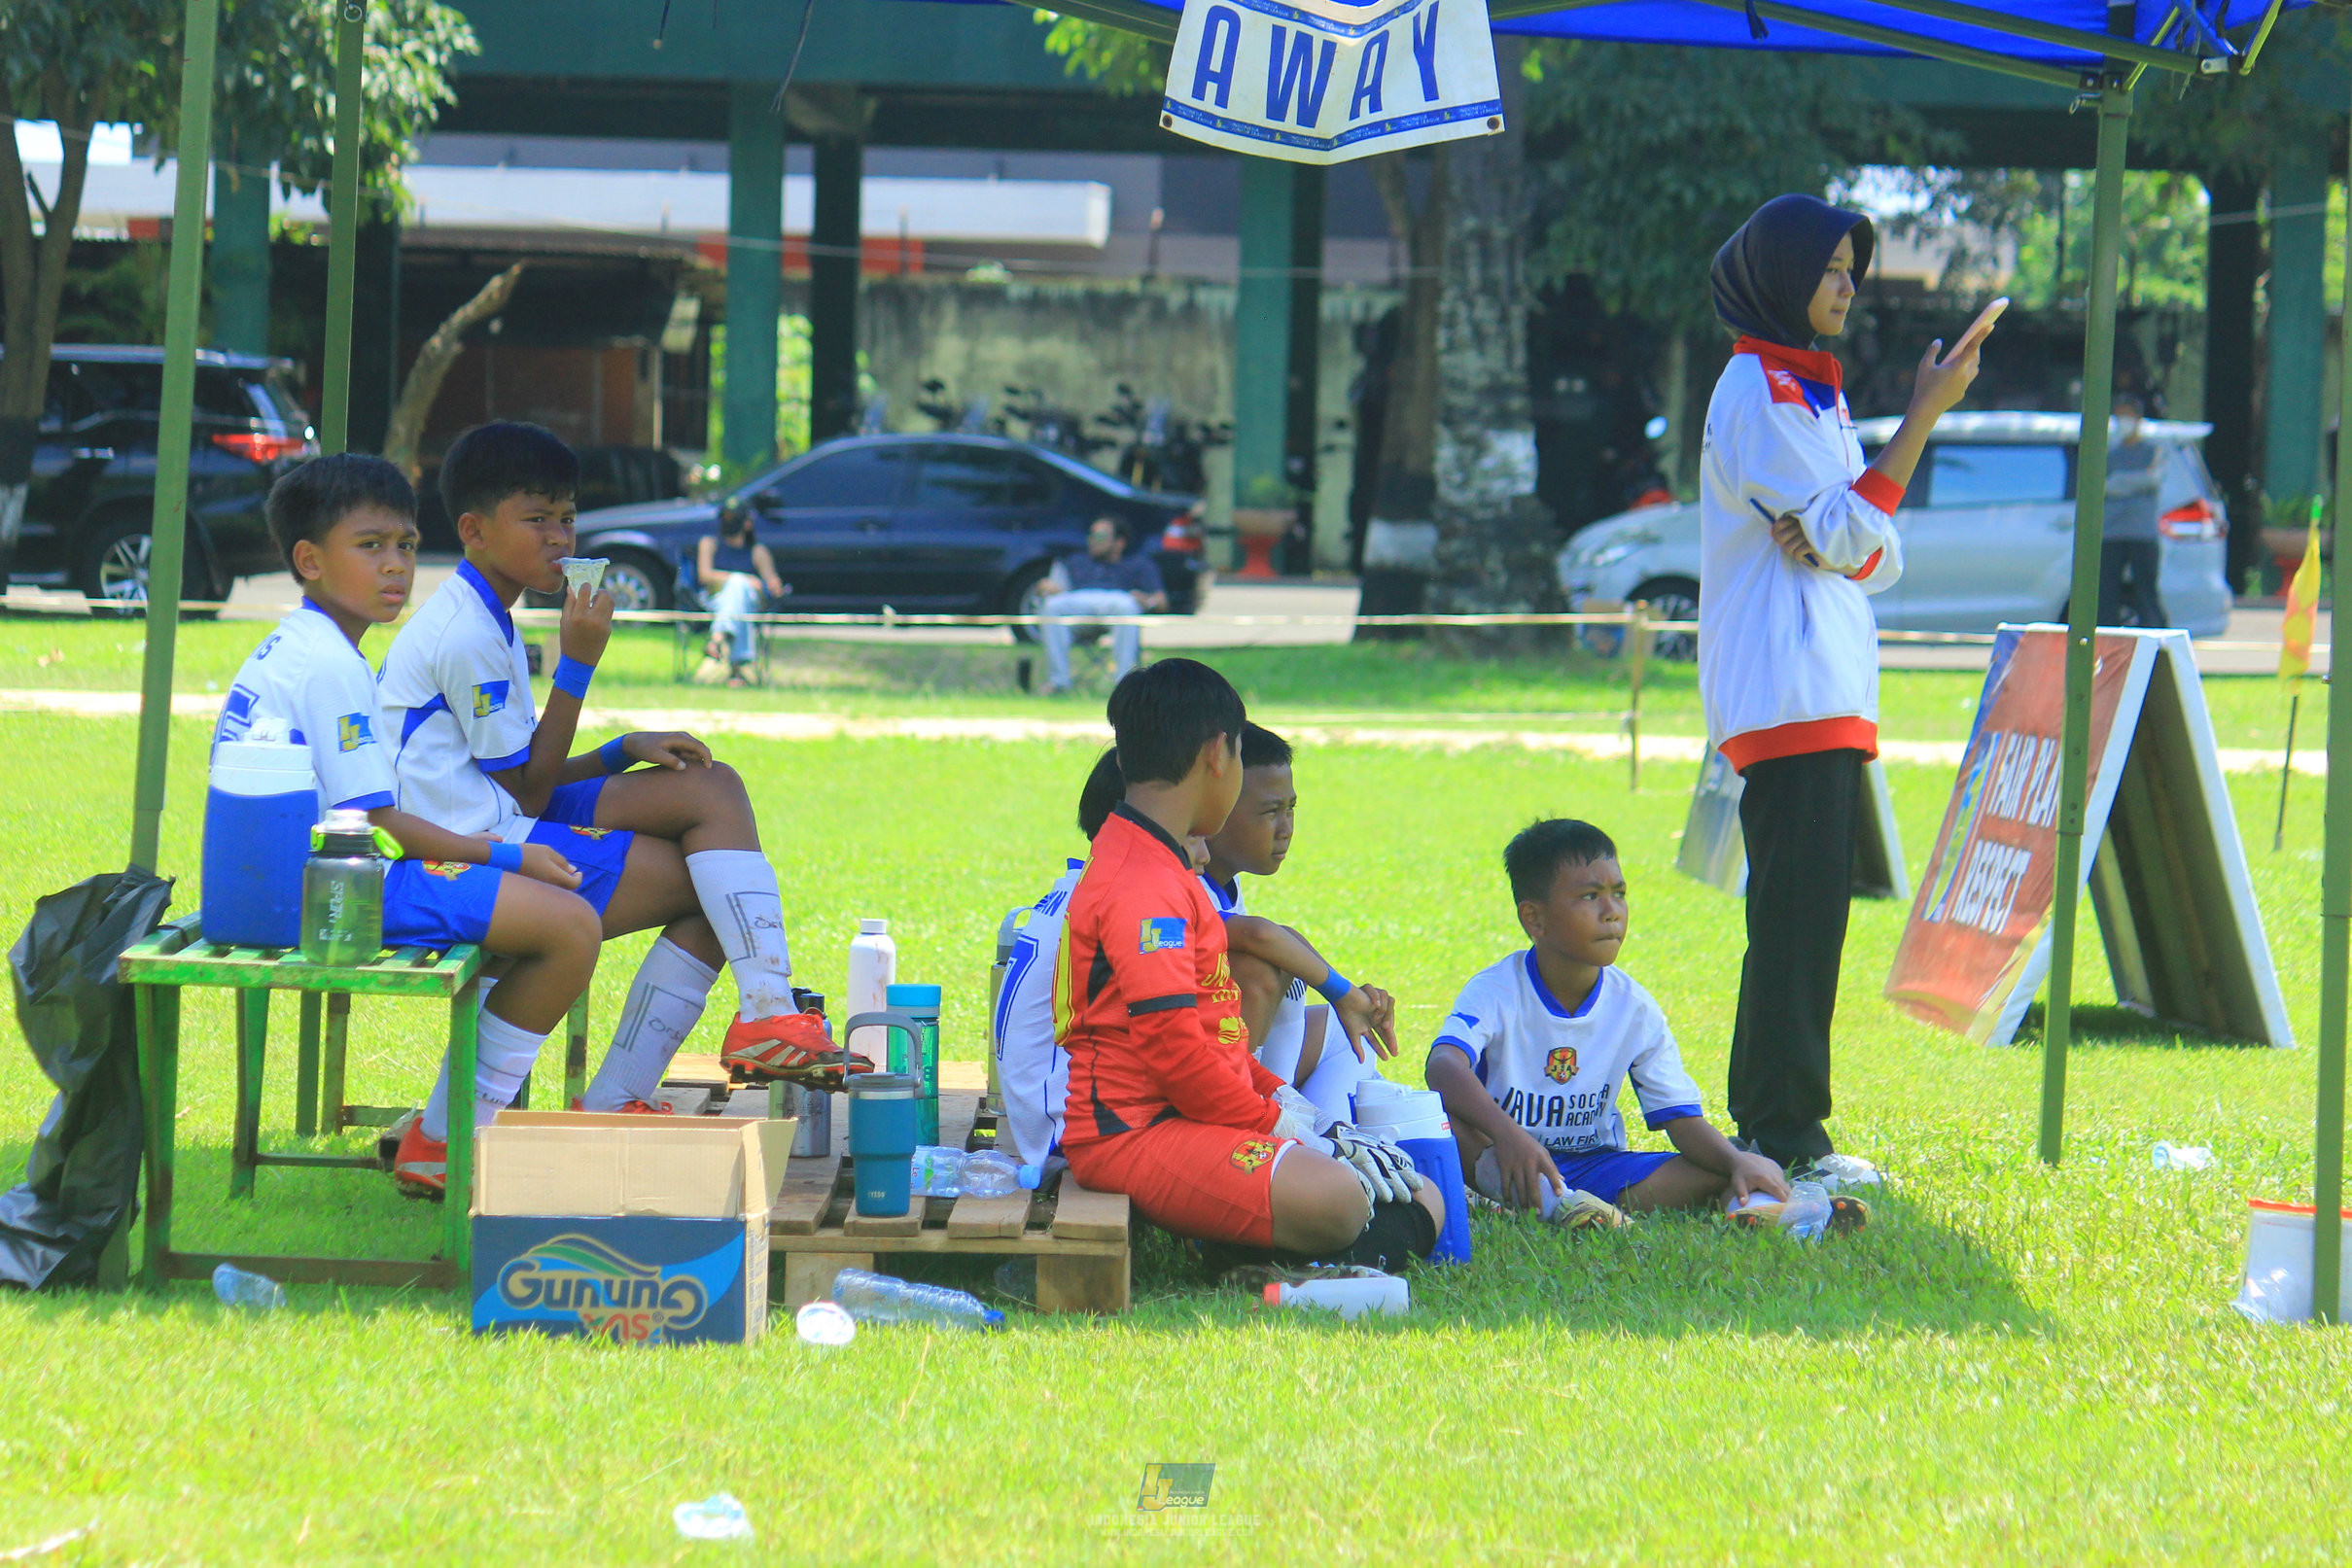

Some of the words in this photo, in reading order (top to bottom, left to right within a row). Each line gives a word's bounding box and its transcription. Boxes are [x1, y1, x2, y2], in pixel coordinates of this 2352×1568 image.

[1191, 1, 1440, 128] AWAY
[1950, 837, 2032, 936] RESPECT
[1153, 939, 1183, 949] League
[1544, 1136, 1574, 1147] LAW
[1576, 1133, 1599, 1146] FIR
